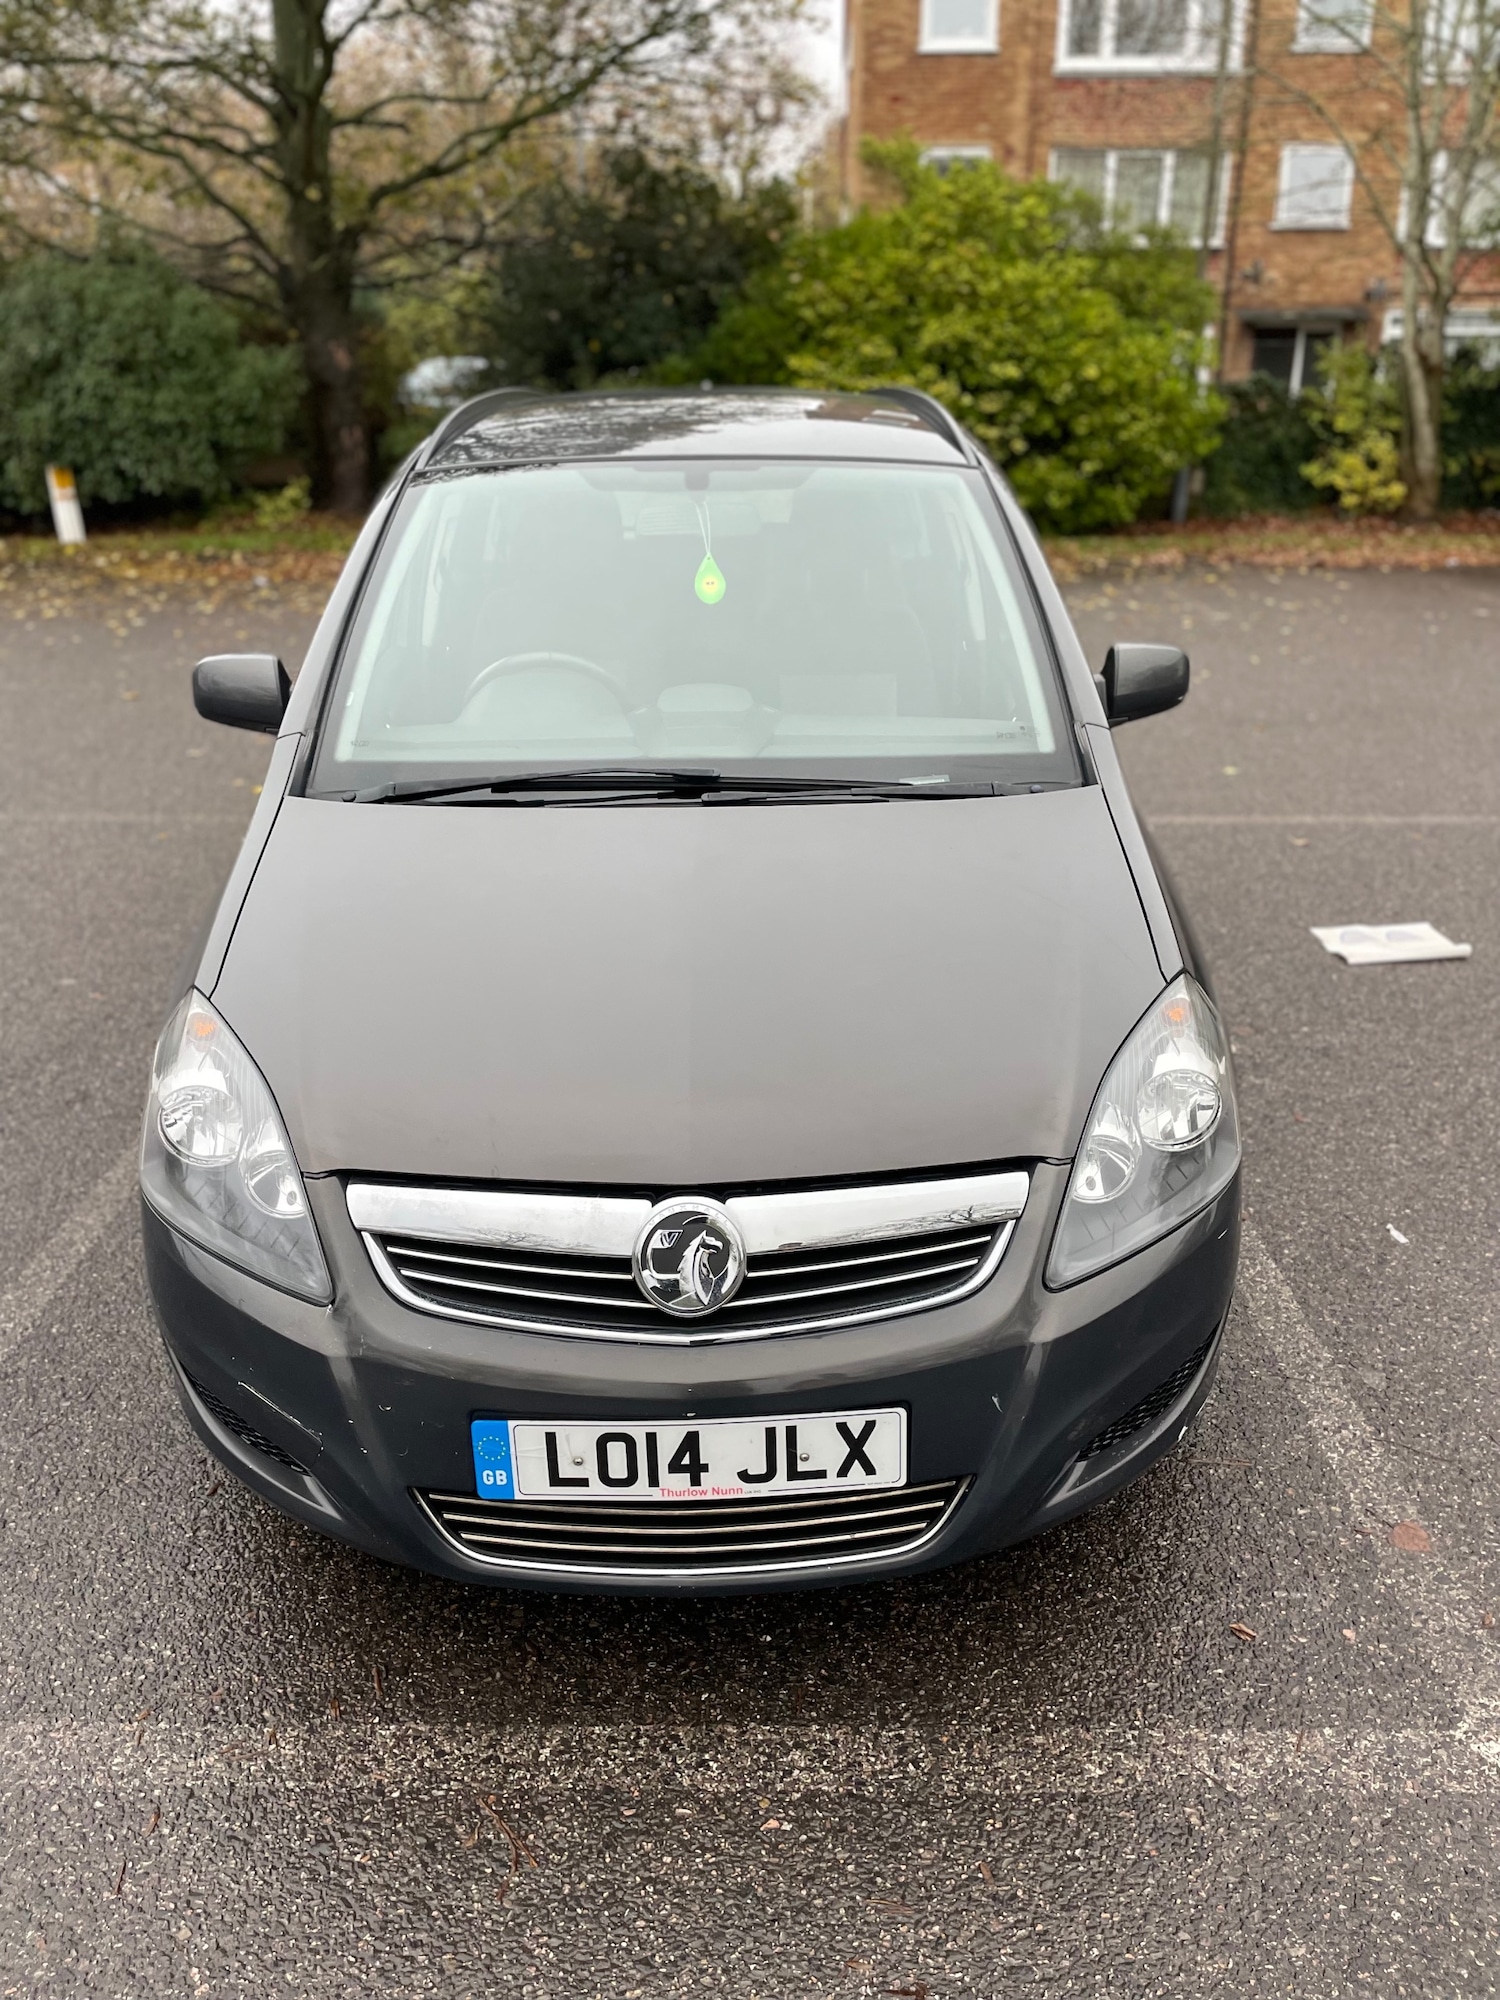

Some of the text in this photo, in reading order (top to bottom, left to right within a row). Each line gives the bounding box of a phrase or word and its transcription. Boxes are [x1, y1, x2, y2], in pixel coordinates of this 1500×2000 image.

[545, 1419, 877, 1488] LO14 JLX
[482, 1469, 508, 1486] GB
[660, 1487, 708, 1498] Thurlow
[711, 1486, 743, 1496] Nunn
